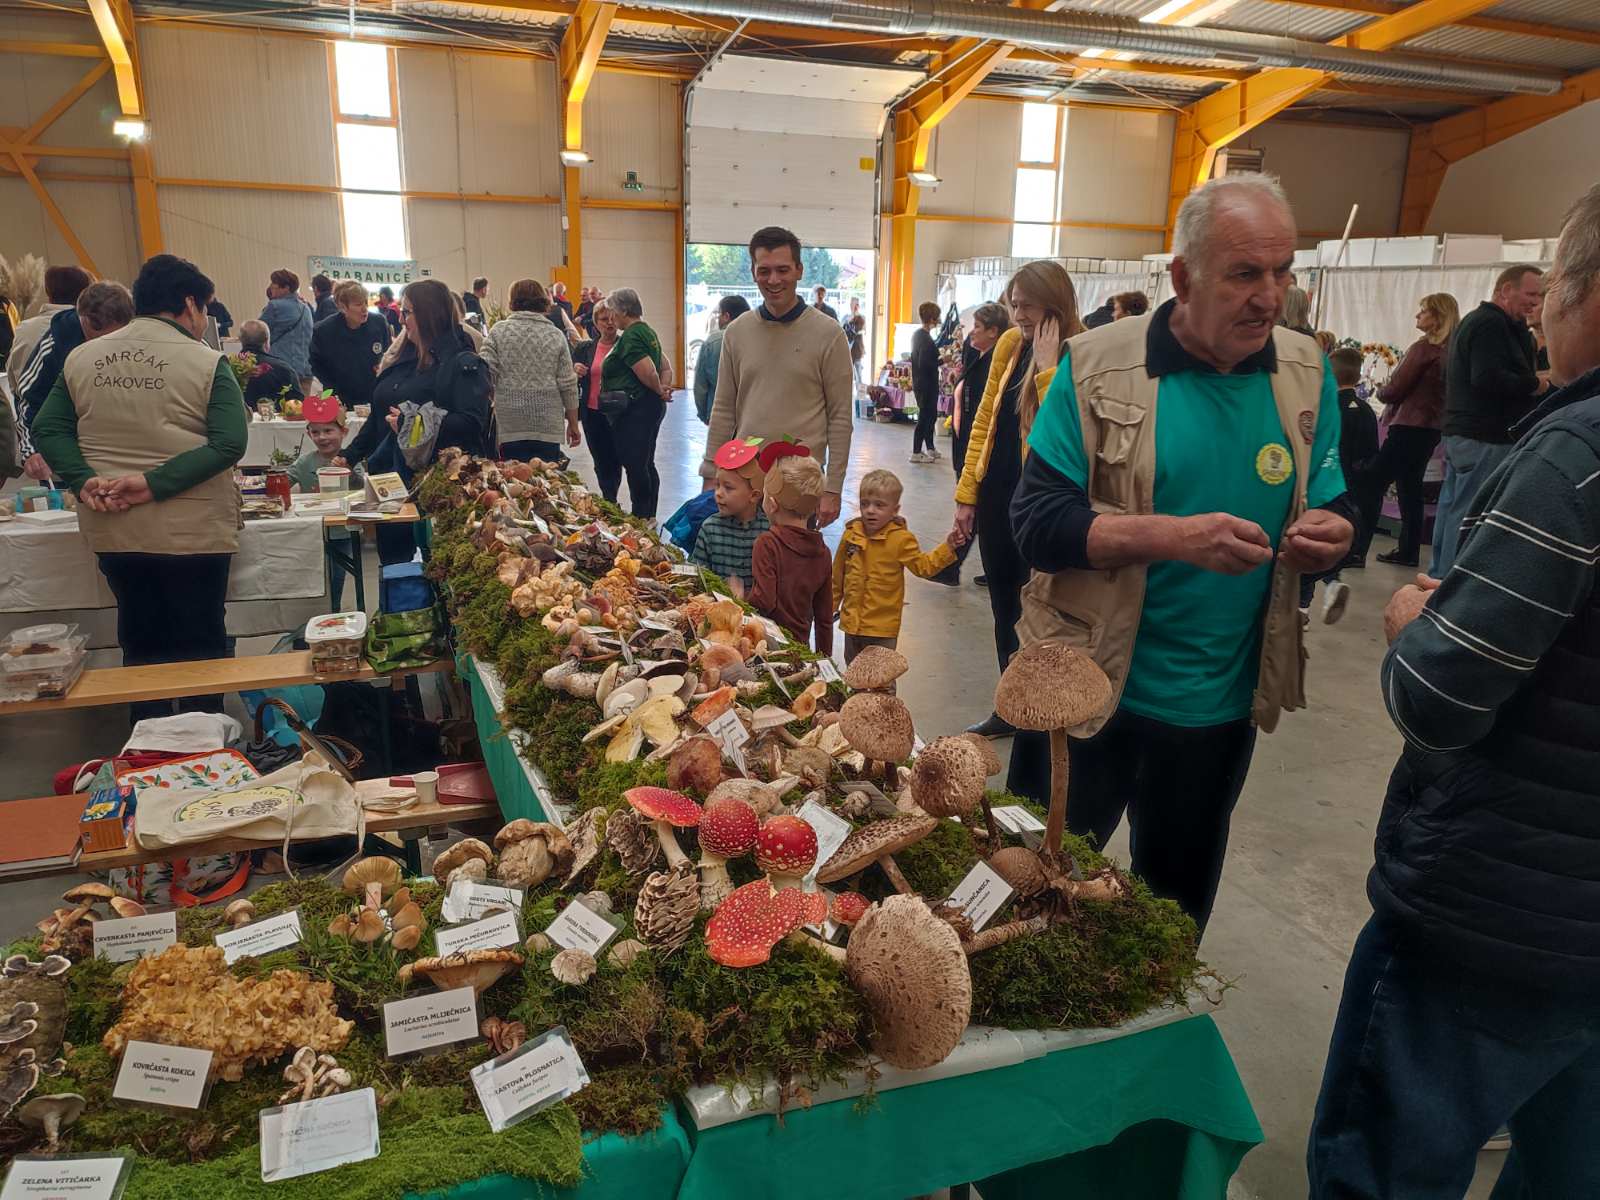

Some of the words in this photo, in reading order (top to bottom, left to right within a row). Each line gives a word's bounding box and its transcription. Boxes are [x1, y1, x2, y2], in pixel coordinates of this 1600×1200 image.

[321, 269, 411, 283] GRABANICE
[94, 349, 169, 373] SMRČAK
[94, 373, 166, 390] ČAKOVEC
[391, 1015, 429, 1028] JAMIČASTA
[430, 1006, 472, 1020] MLIJEČNICA
[132, 1062, 169, 1073] KOVRČASTA
[170, 1066, 196, 1077] KOKICA
[55, 1175, 101, 1184] VITIČARKA
